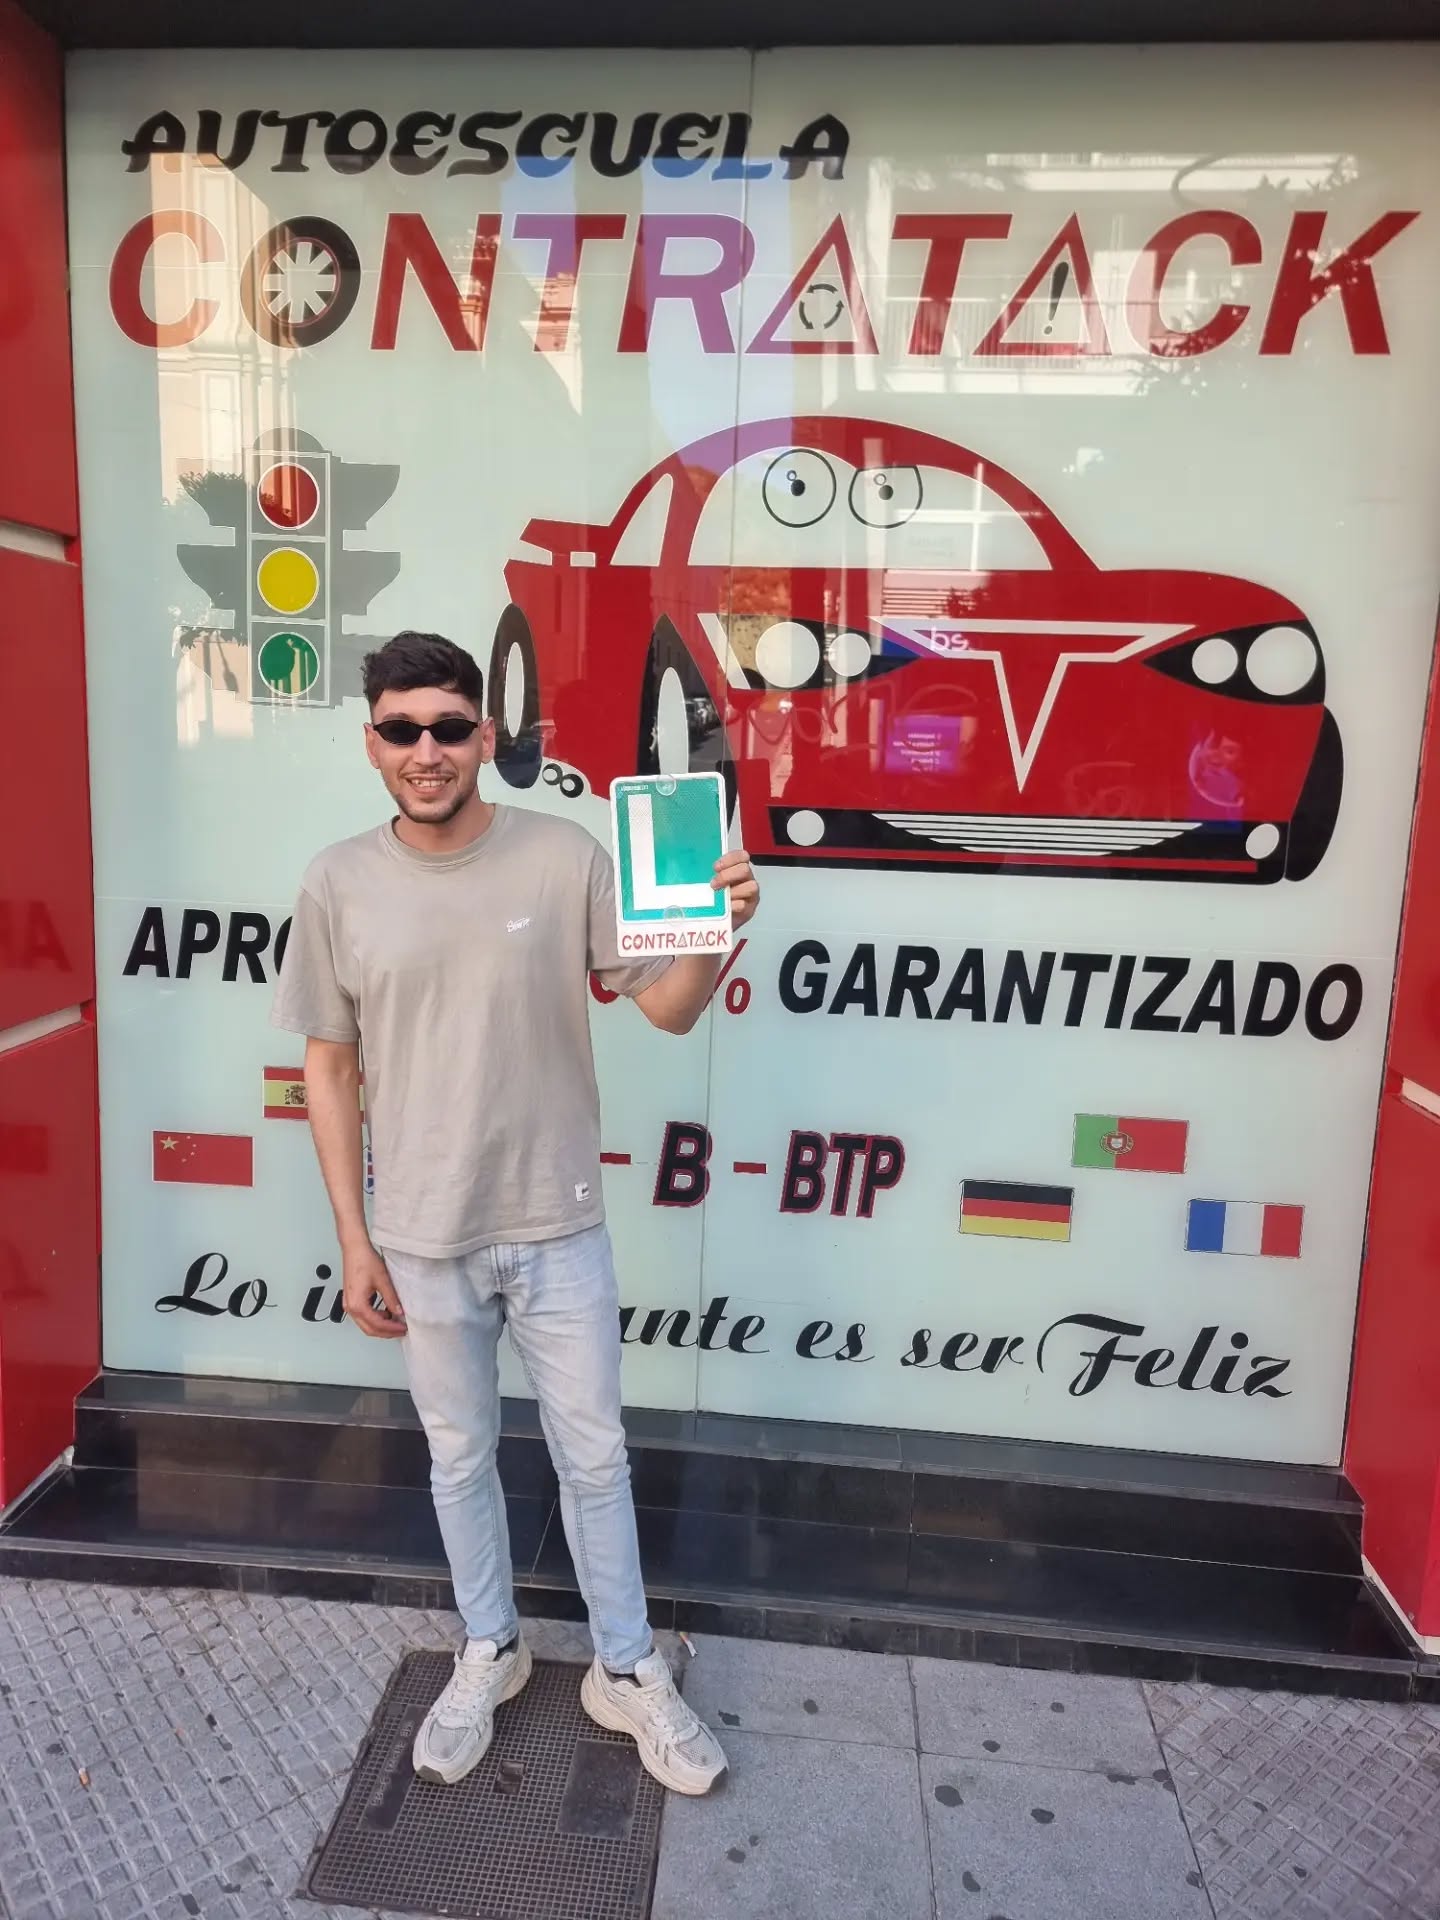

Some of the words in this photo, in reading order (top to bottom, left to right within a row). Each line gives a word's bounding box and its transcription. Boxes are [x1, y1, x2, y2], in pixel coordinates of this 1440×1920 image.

[121, 109, 850, 181] AUTOESCUELA
[109, 208, 1422, 359] CONTRATACK
[627, 793, 715, 911] L
[621, 929, 729, 951] CONTRATACK
[779, 939, 1364, 1042] GARANTIZADO
[652, 1120, 713, 1207] B
[778, 1130, 906, 1218] BTP
[154, 1252, 278, 1318] Lo
[795, 1320, 875, 1362] es
[900, 1328, 1025, 1374] ser
[1036, 1313, 1293, 1399] Feliz
